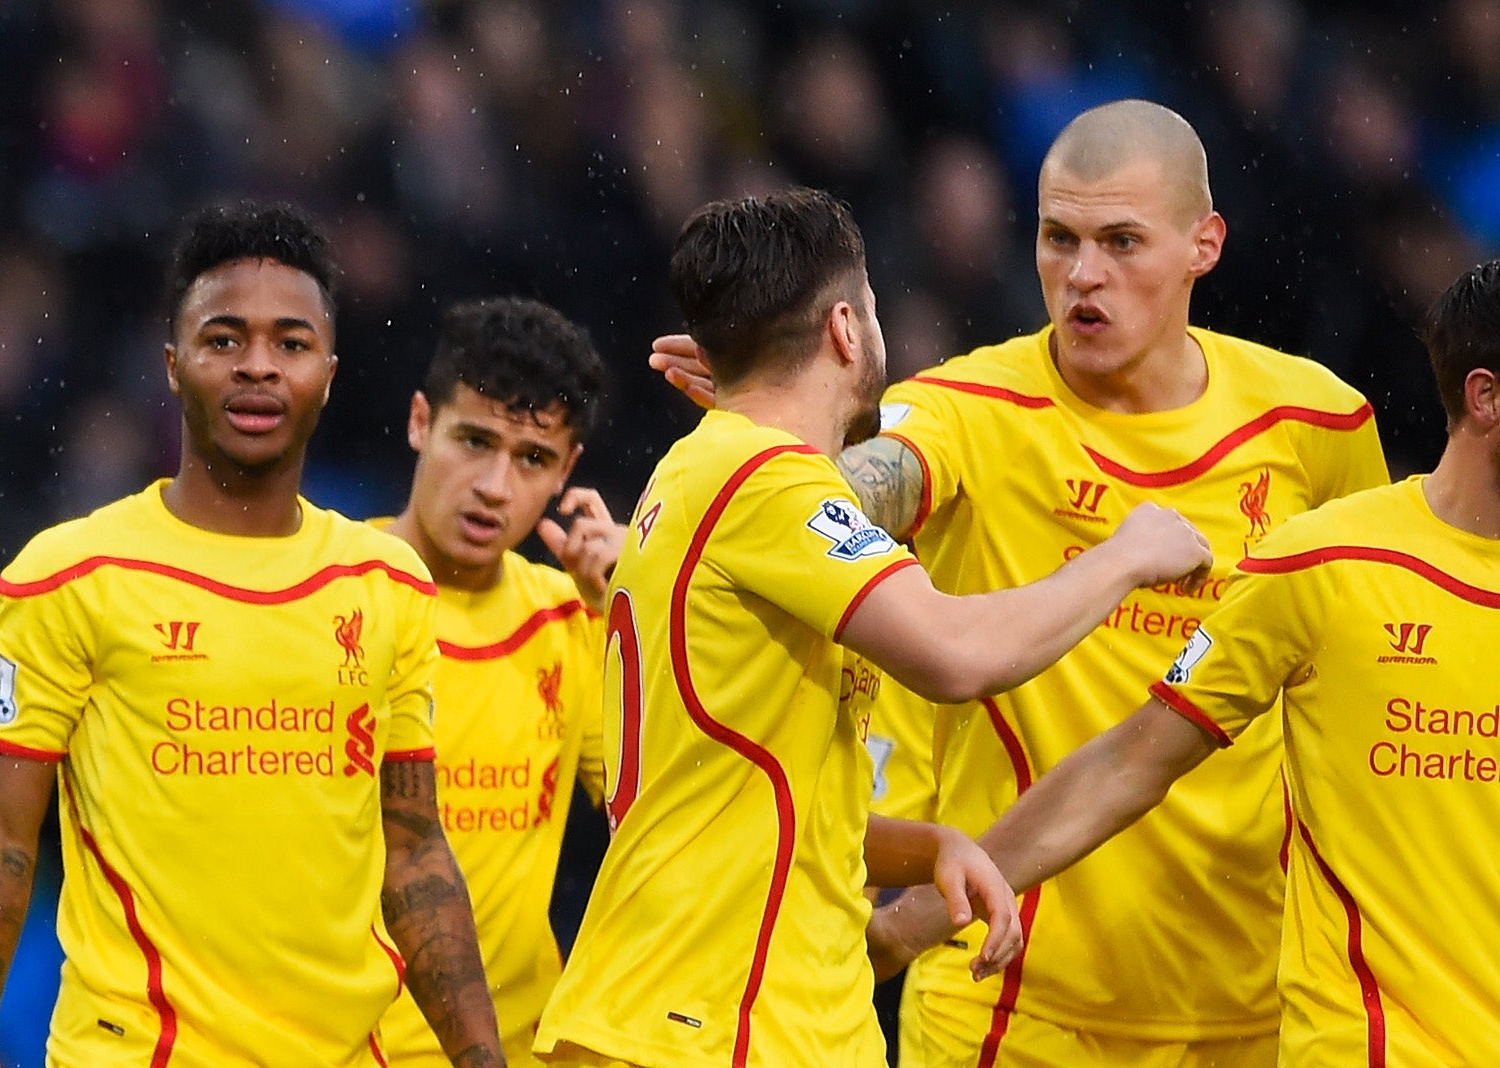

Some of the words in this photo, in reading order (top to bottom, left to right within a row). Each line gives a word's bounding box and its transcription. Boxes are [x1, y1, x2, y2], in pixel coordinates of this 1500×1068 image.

[1377, 655, 1435, 665] WARRIOR
[166, 698, 334, 733] Standard
[1385, 697, 1500, 738] Stand
[151, 741, 333, 776] Chartered
[435, 758, 531, 789] ndard
[1369, 741, 1500, 782] Charte
[444, 801, 529, 832] tered
